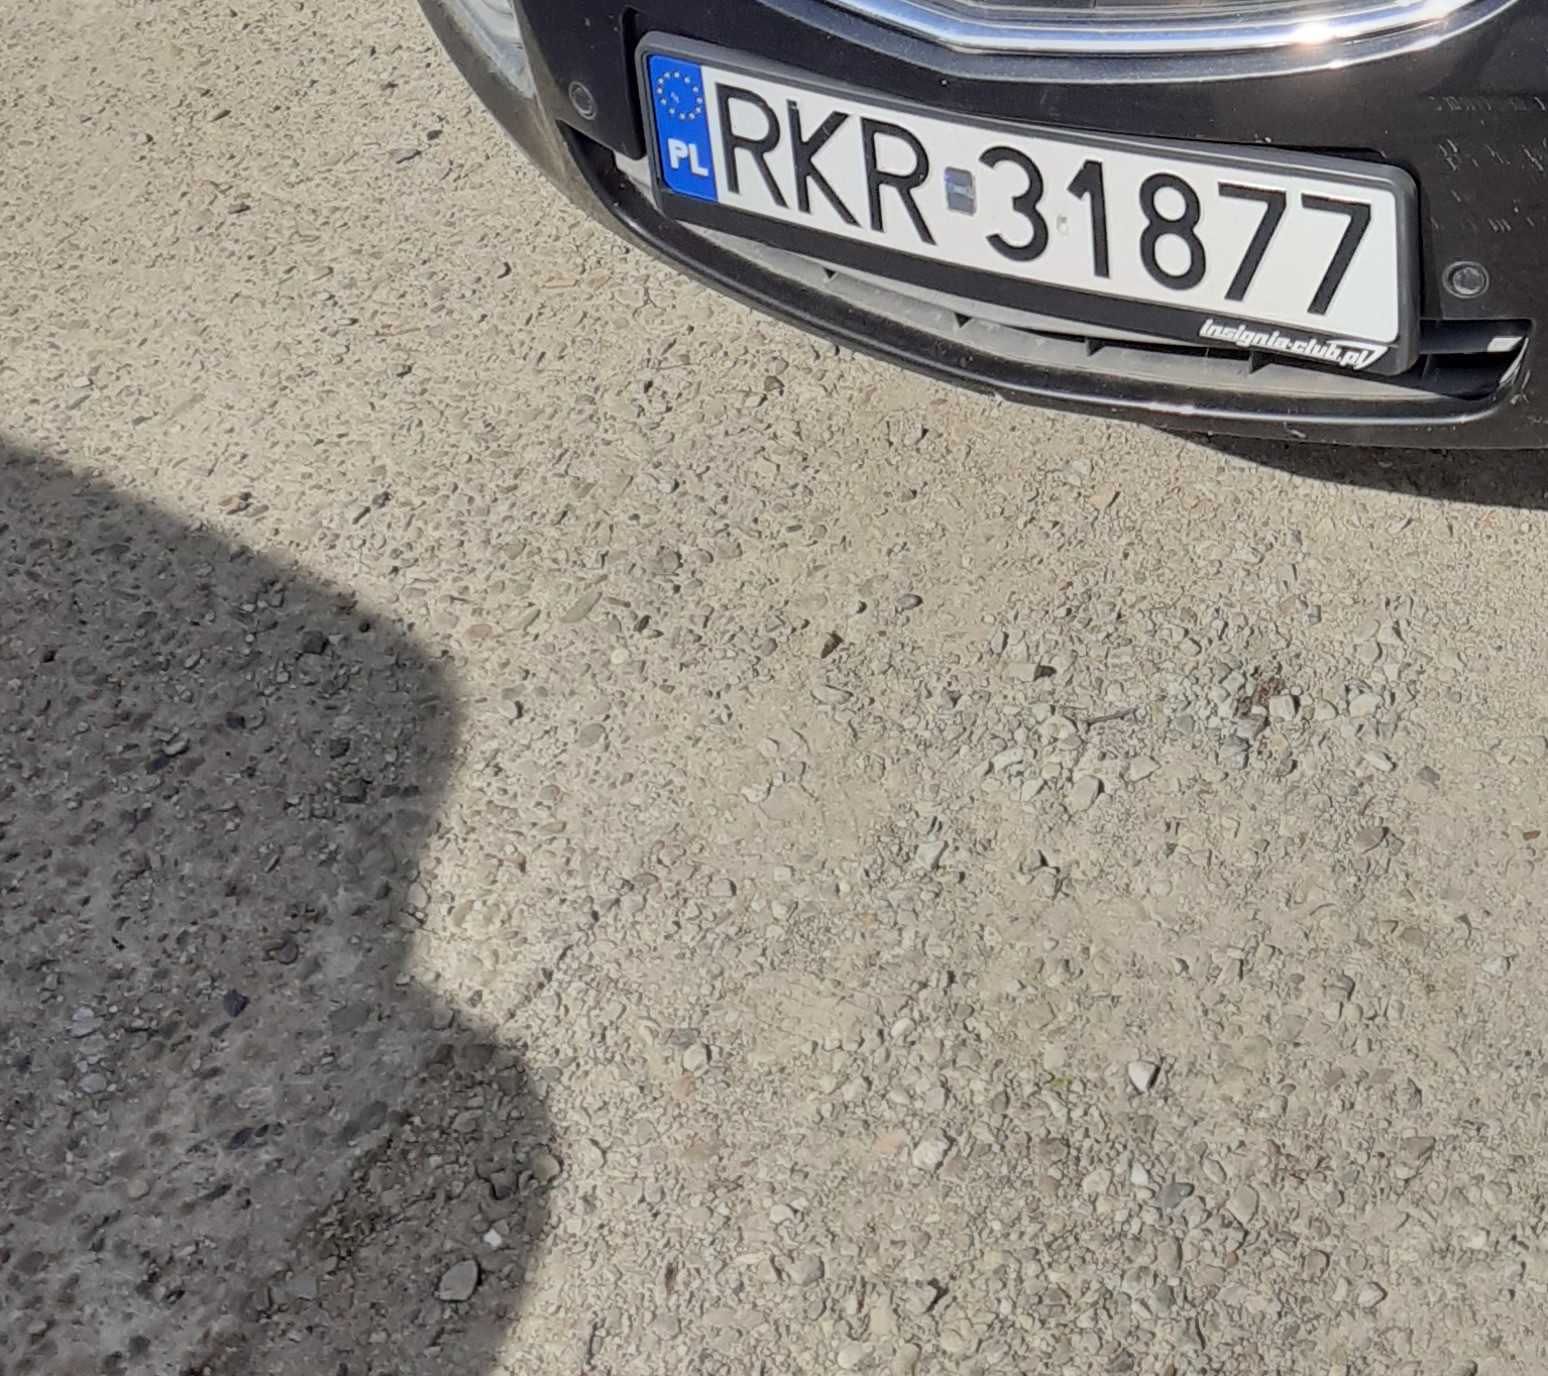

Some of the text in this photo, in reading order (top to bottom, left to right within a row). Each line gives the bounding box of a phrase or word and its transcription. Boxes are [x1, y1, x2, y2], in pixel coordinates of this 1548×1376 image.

[667, 137, 709, 177] PL
[715, 82, 1372, 317] RKR 31877
